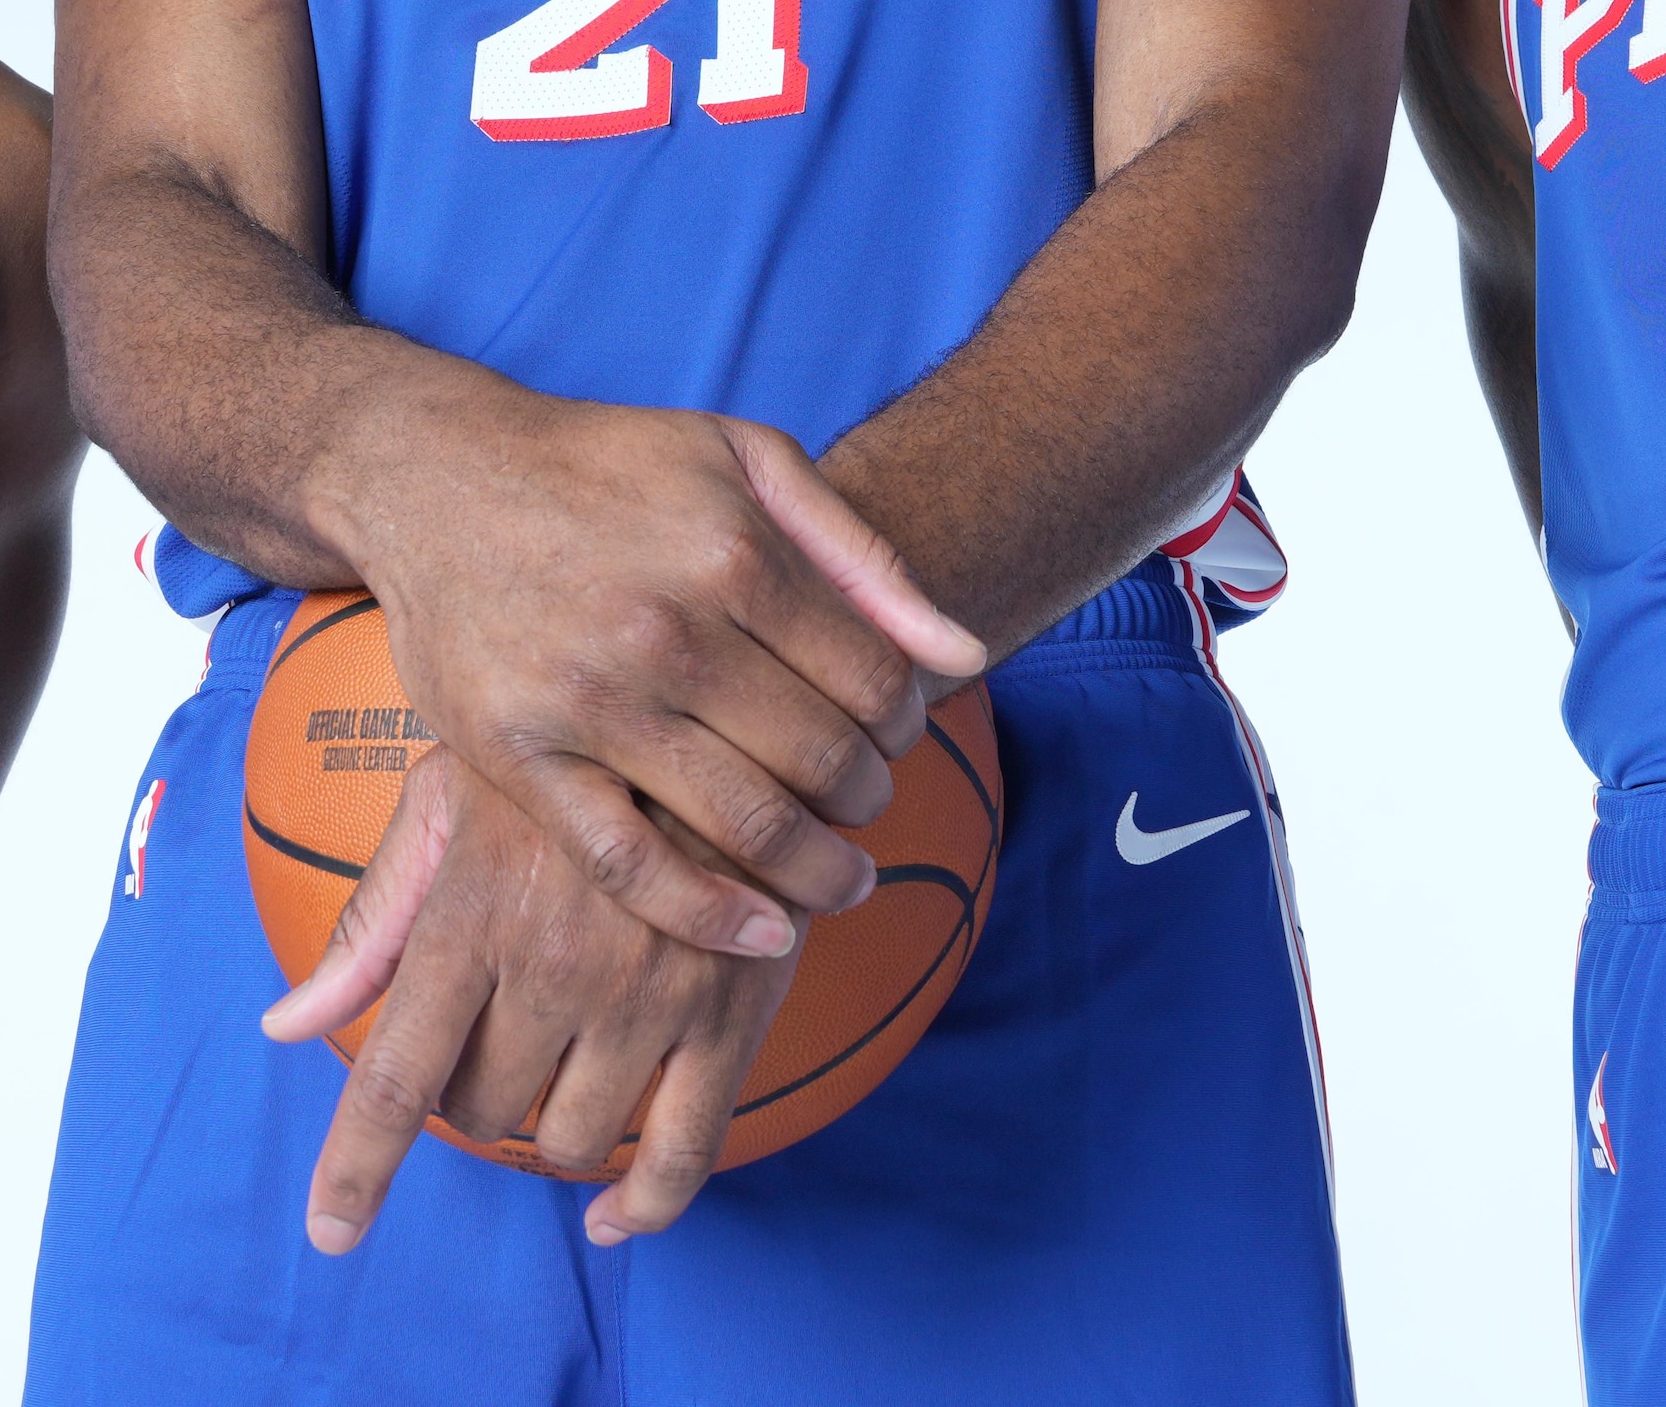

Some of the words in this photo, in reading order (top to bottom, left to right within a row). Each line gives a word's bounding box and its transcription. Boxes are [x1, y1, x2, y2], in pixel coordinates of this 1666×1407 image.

[306, 708, 358, 742] OFFICIAL
[359, 707, 403, 740] GAME
[402, 708, 439, 741] BAL
[323, 746, 361, 772] GENUINE
[363, 746, 408, 772] LEATHER
